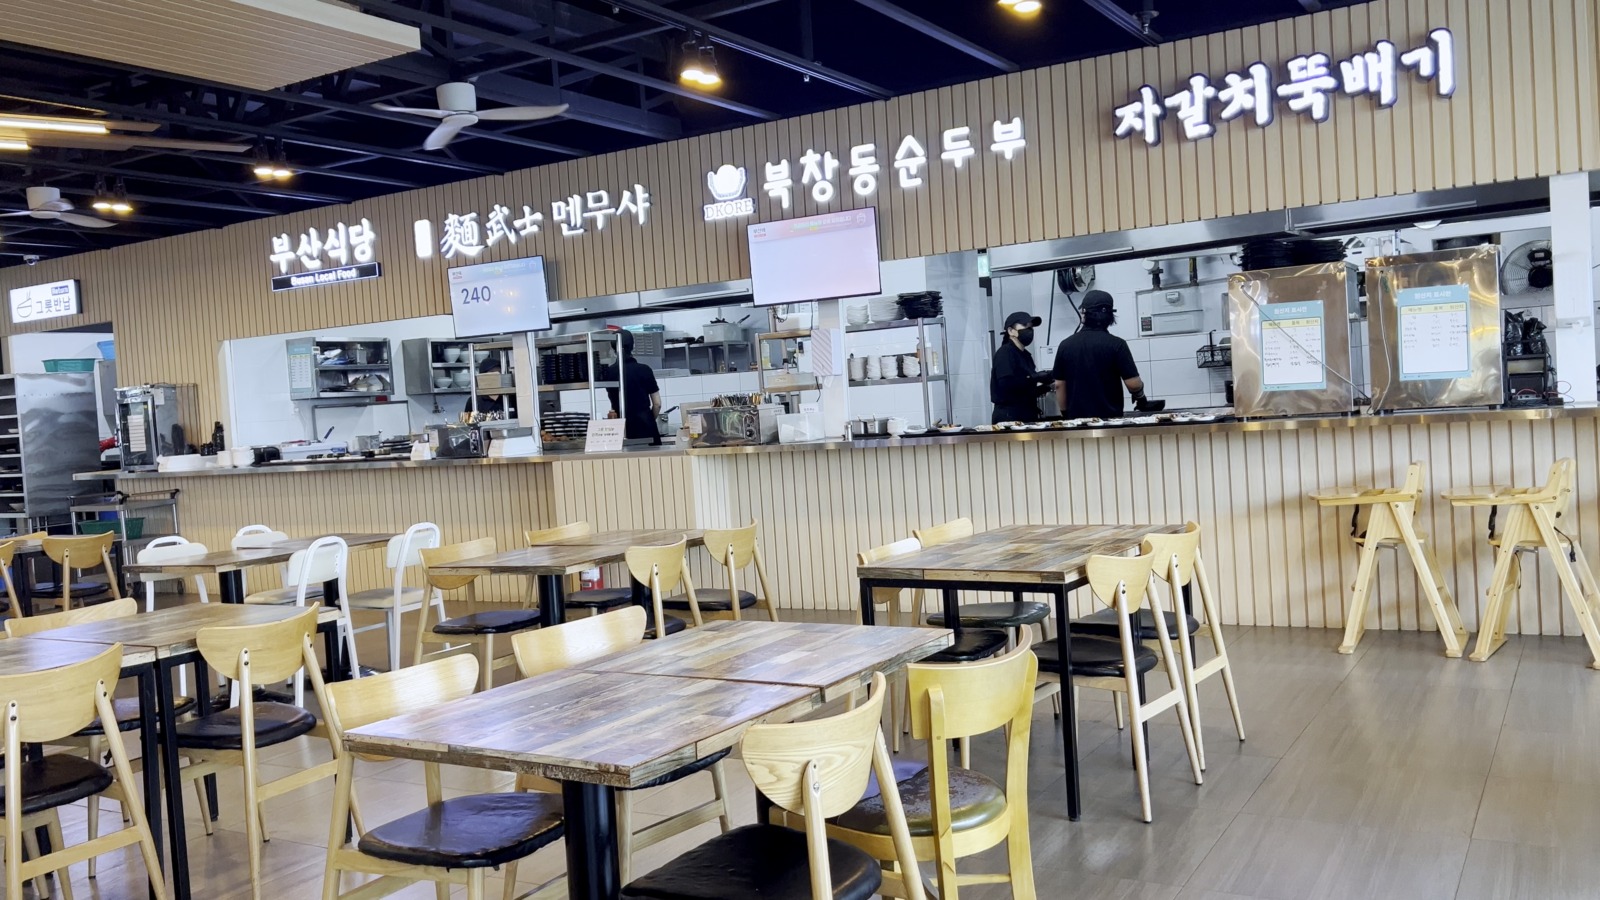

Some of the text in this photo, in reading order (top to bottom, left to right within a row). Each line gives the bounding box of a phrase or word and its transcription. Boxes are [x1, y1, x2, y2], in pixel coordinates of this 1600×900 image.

[1113, 28, 1456, 147] 자갈치뚝배기
[551, 183, 651, 237] 멘무샤
[704, 198, 753, 220] DKORE
[269, 217, 376, 274] 부산식당
[290, 268, 357, 287] Busan Local Food
[461, 285, 491, 305] 240
